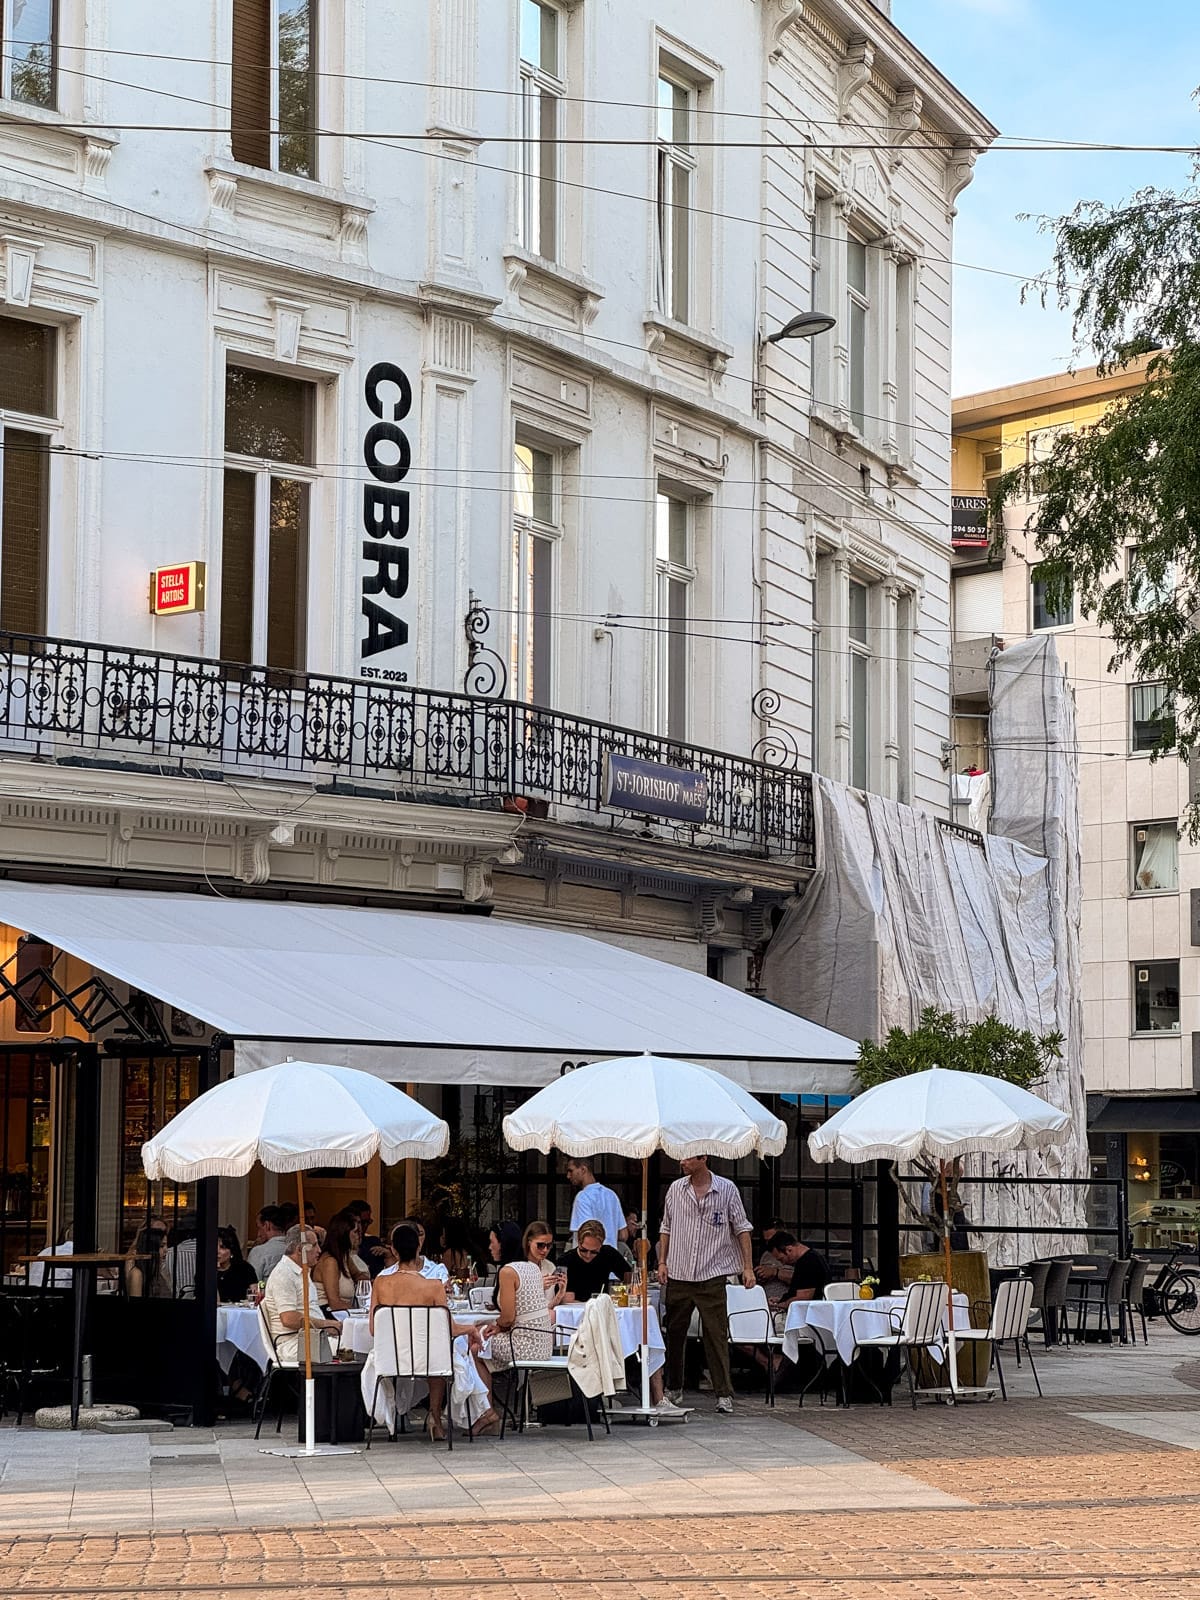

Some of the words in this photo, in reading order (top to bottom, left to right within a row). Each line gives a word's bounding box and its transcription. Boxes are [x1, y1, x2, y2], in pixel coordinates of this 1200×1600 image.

[361, 361, 412, 659] COBRA
[161, 573, 184, 589] STELLA
[161, 588, 185, 604] ARTOIS
[616, 770, 680, 802] ST-JORISHOF
[682, 790, 703, 808] MAES
